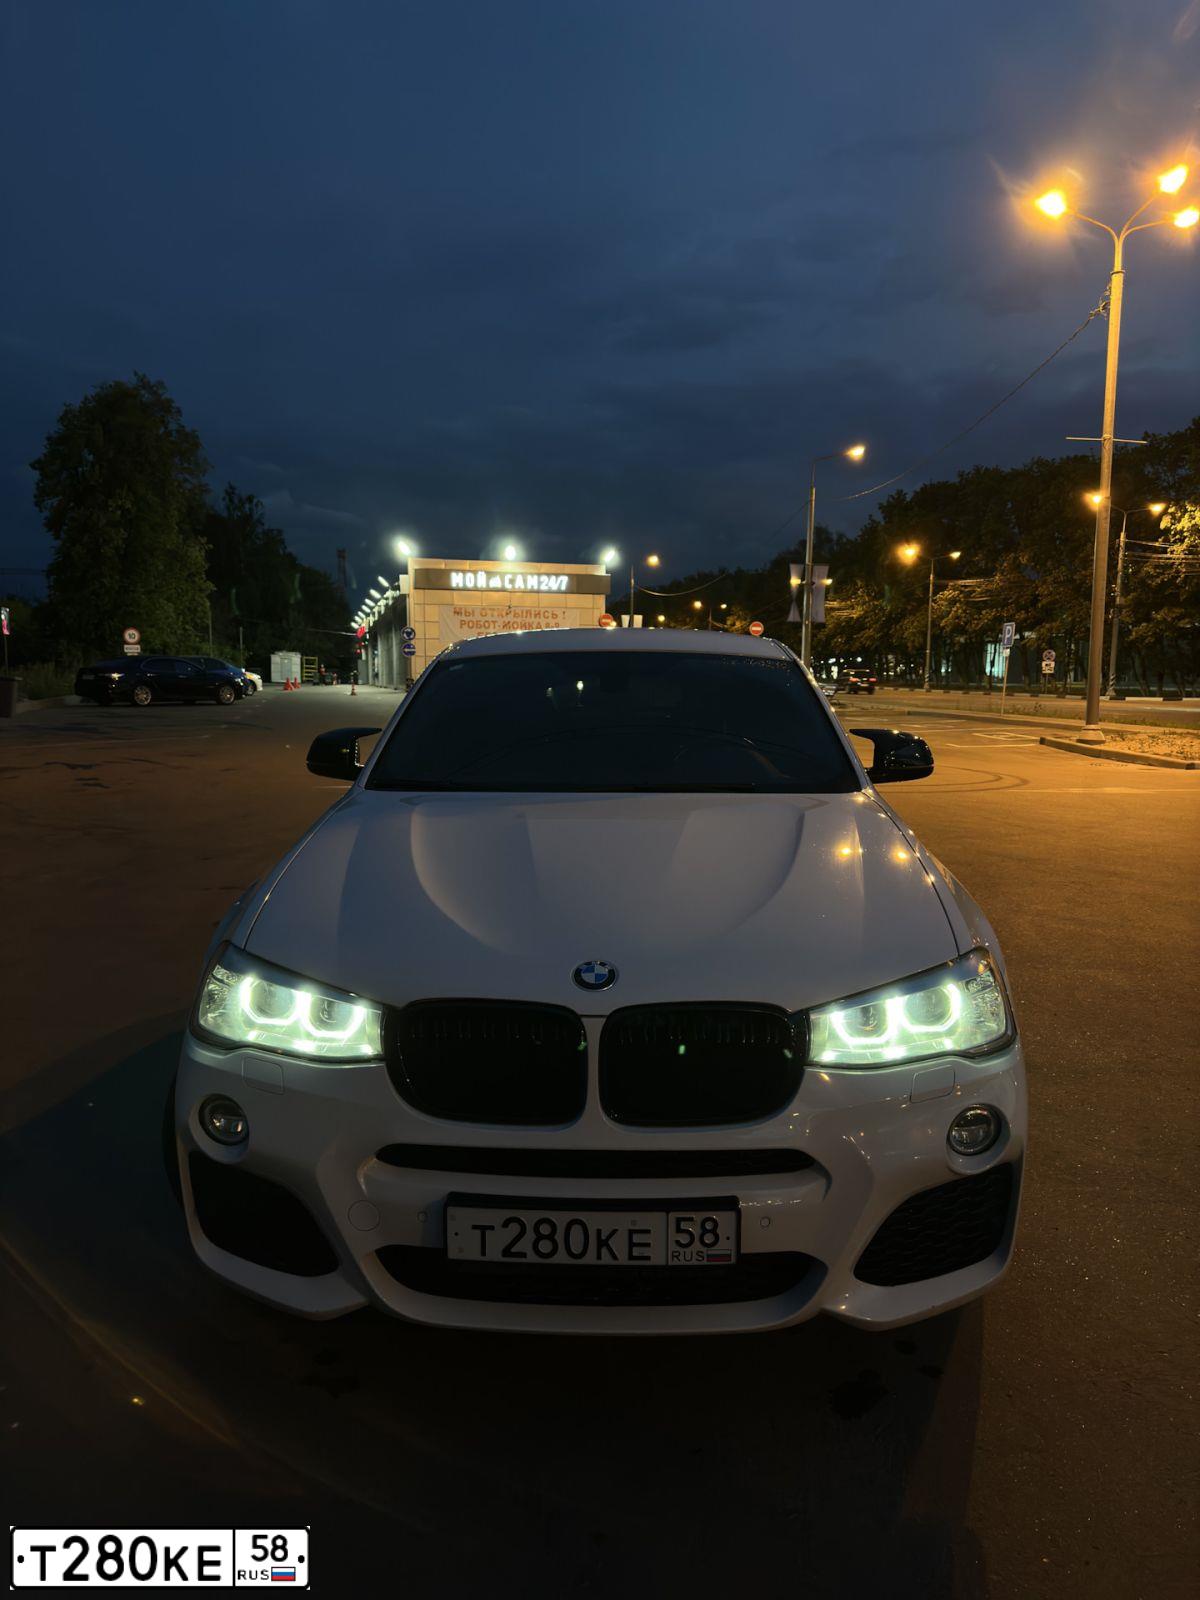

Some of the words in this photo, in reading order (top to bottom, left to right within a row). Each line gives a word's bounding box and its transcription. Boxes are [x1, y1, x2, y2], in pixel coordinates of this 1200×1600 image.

[451, 571, 486, 588] МОЙ
[674, 1217, 719, 1249] 58
[672, 1251, 704, 1262] RUS
